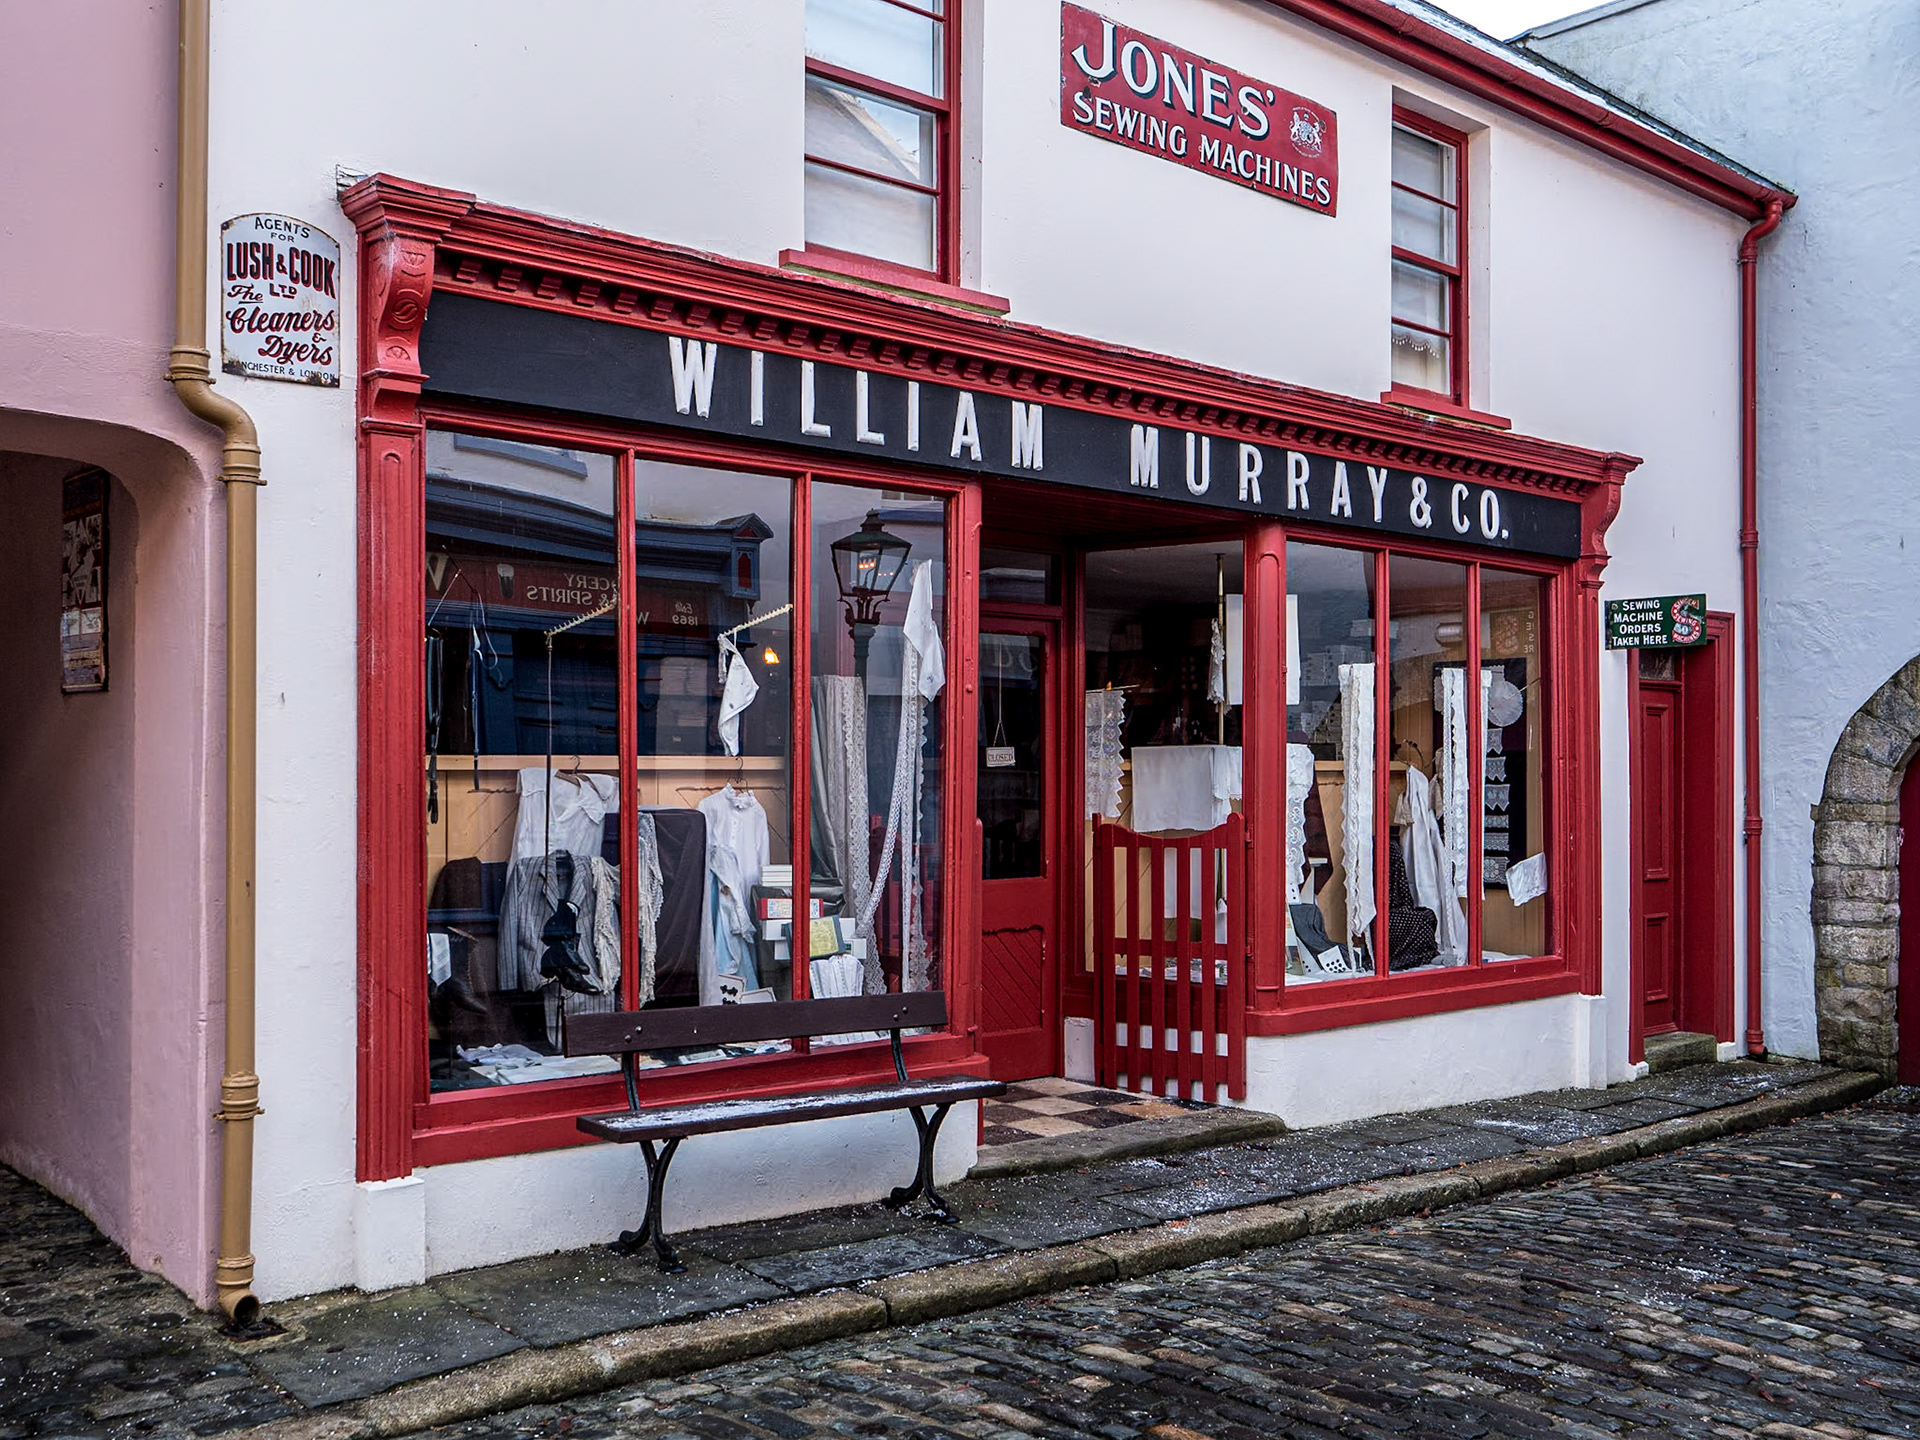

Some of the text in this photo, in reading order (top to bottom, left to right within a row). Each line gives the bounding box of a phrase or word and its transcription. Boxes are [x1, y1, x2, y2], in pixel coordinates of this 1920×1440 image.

[1071, 18, 1275, 141] JONES'
[1072, 91, 1187, 156] SEWING
[1199, 134, 1331, 206] MACHINES
[254, 216, 311, 239] AGENTS
[270, 232, 295, 243] FOR
[227, 241, 336, 299] LUSH & COOK
[227, 283, 263, 303] The
[269, 282, 298, 299] LTD
[226, 306, 335, 333] Cleaners
[312, 332, 327, 343] &
[258, 335, 332, 366] Dyers
[288, 367, 296, 376] &
[668, 335, 1510, 541] WILLIAM MURRAY & CO.
[1622, 600, 1660, 611] SEWING
[1613, 611, 1663, 623] MACHINE
[1620, 623, 1661, 634] ORDERS
[1612, 634, 1668, 646] TAKEN HERE
[988, 753, 1013, 762] CLOSED
